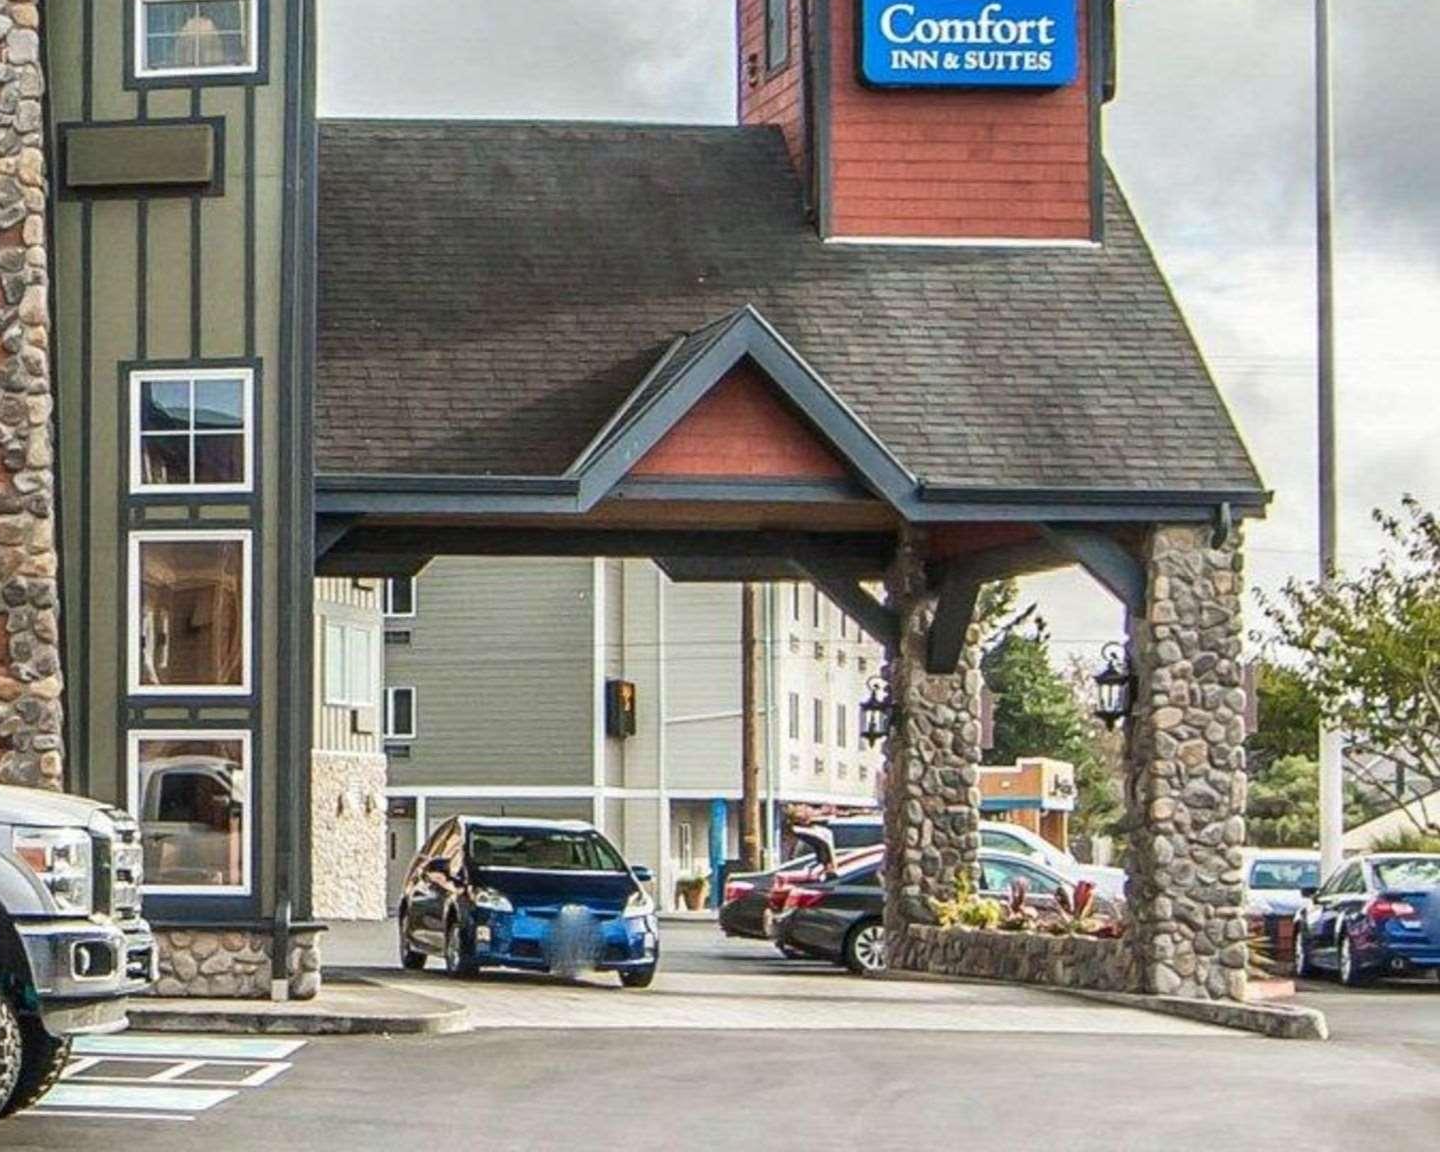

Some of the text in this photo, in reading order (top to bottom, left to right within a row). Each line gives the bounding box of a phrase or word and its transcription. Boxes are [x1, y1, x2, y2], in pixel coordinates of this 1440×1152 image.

[880, 3, 1056, 44] Comfort
[890, 50, 1053, 71] INN & SUITES
